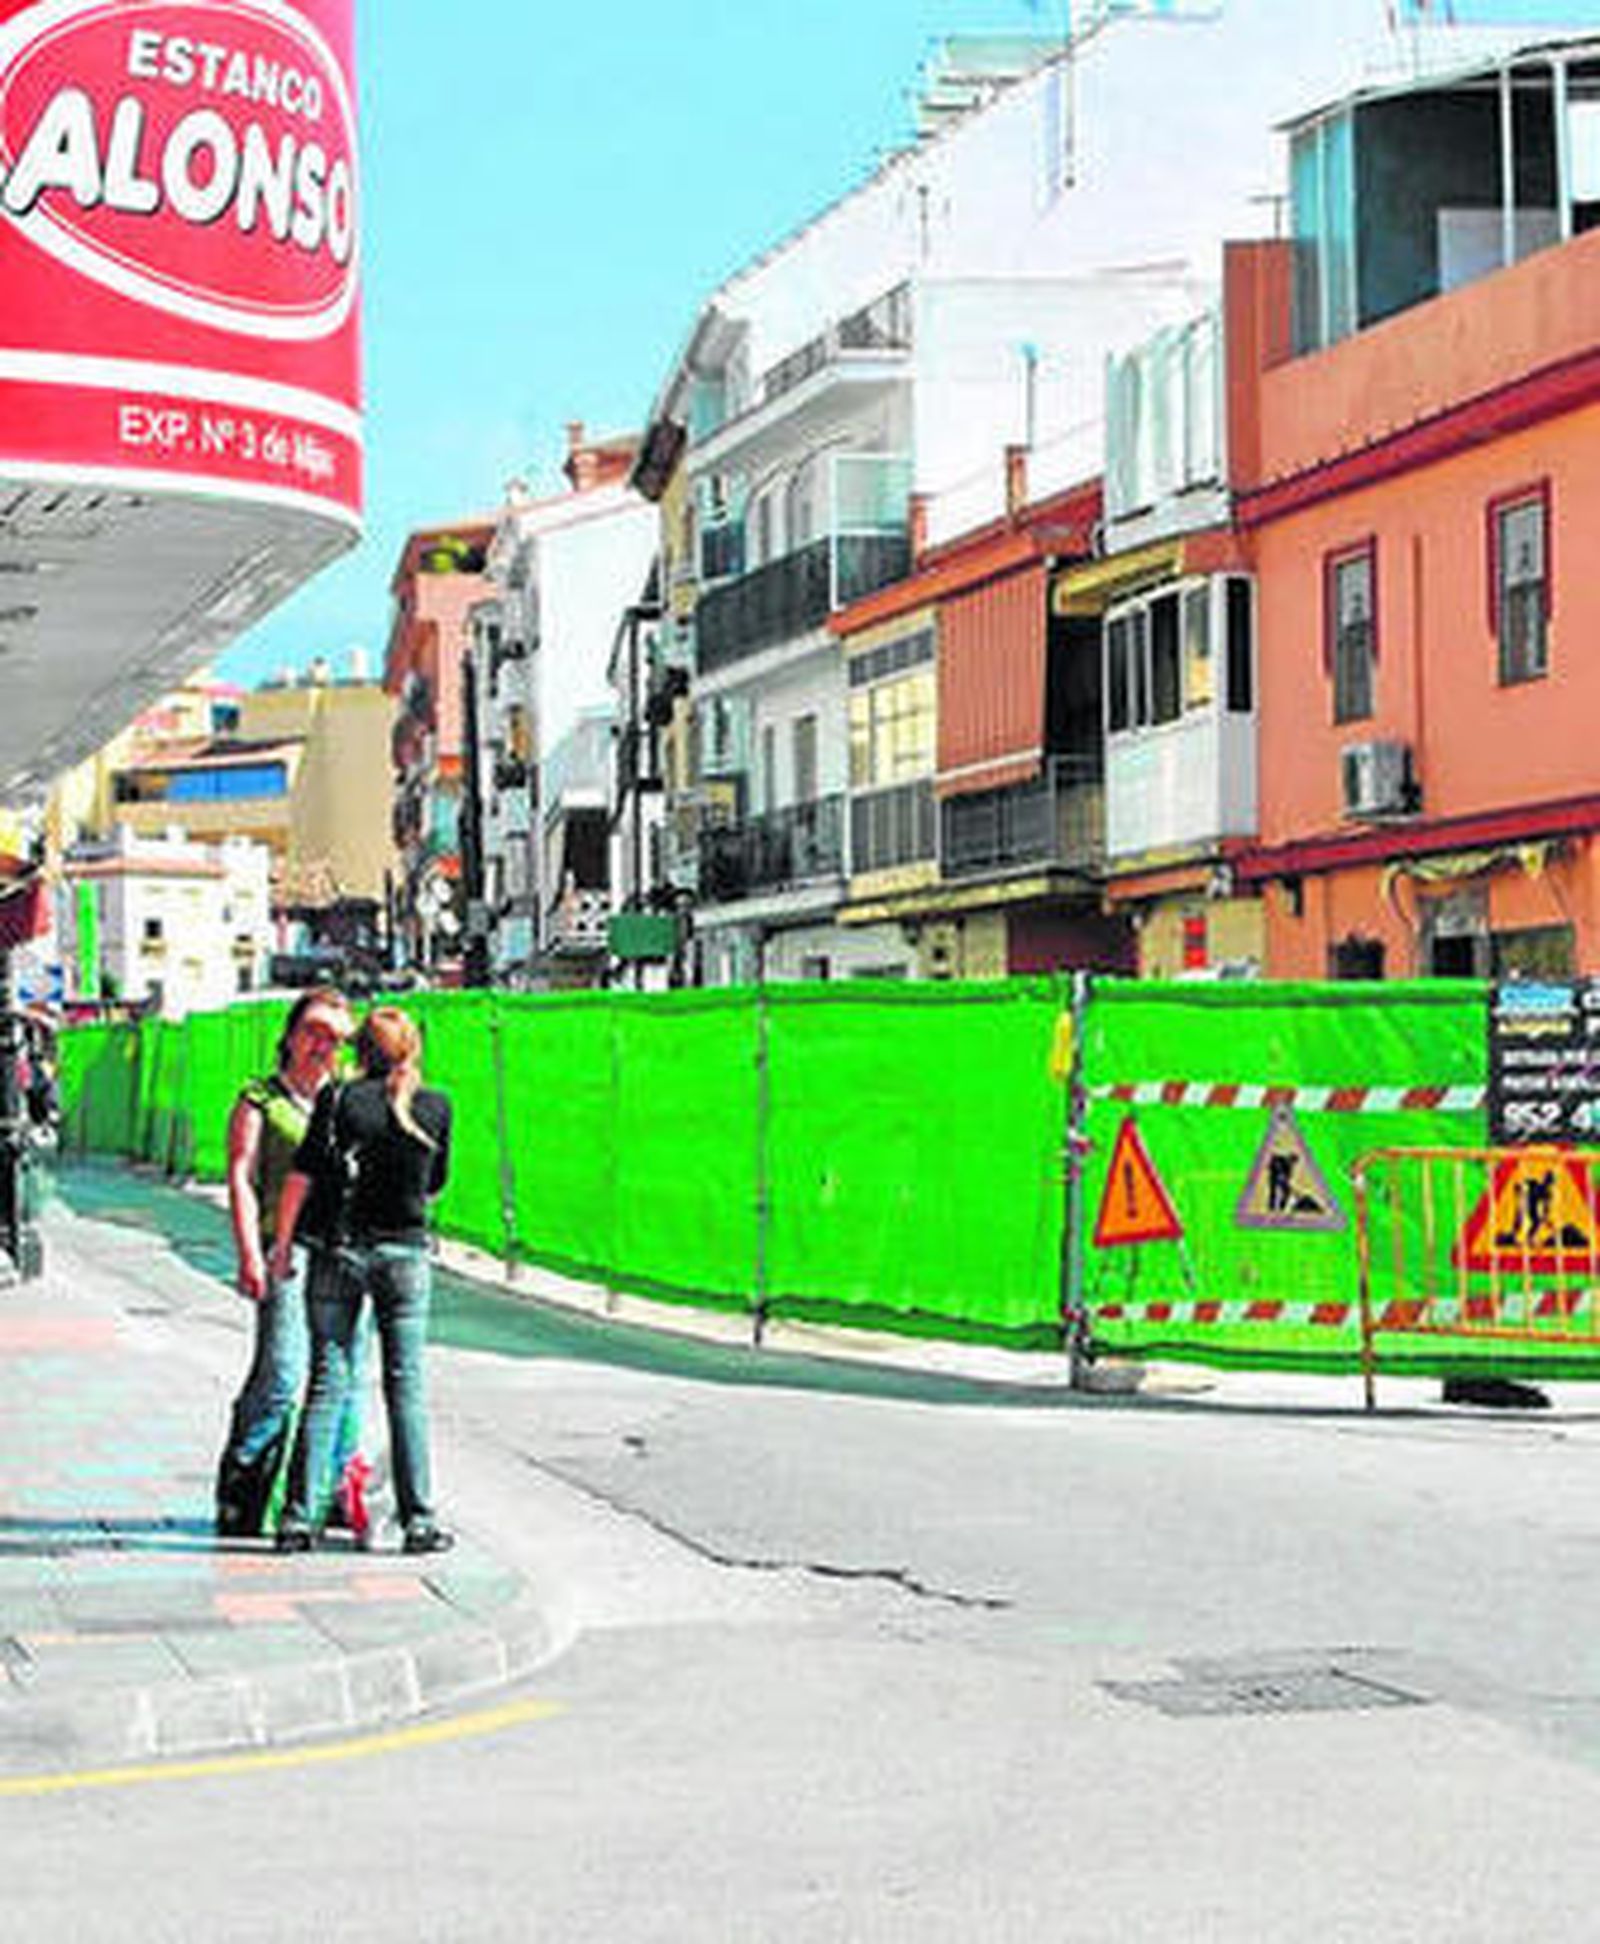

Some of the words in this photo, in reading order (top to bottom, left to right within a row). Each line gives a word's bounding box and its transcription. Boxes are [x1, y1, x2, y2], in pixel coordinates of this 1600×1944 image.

[127, 28, 323, 121] ESTANCO
[3, 86, 353, 268] ALONSO
[119, 405, 193, 450] EXP.
[1503, 1101, 1563, 1134] 952
